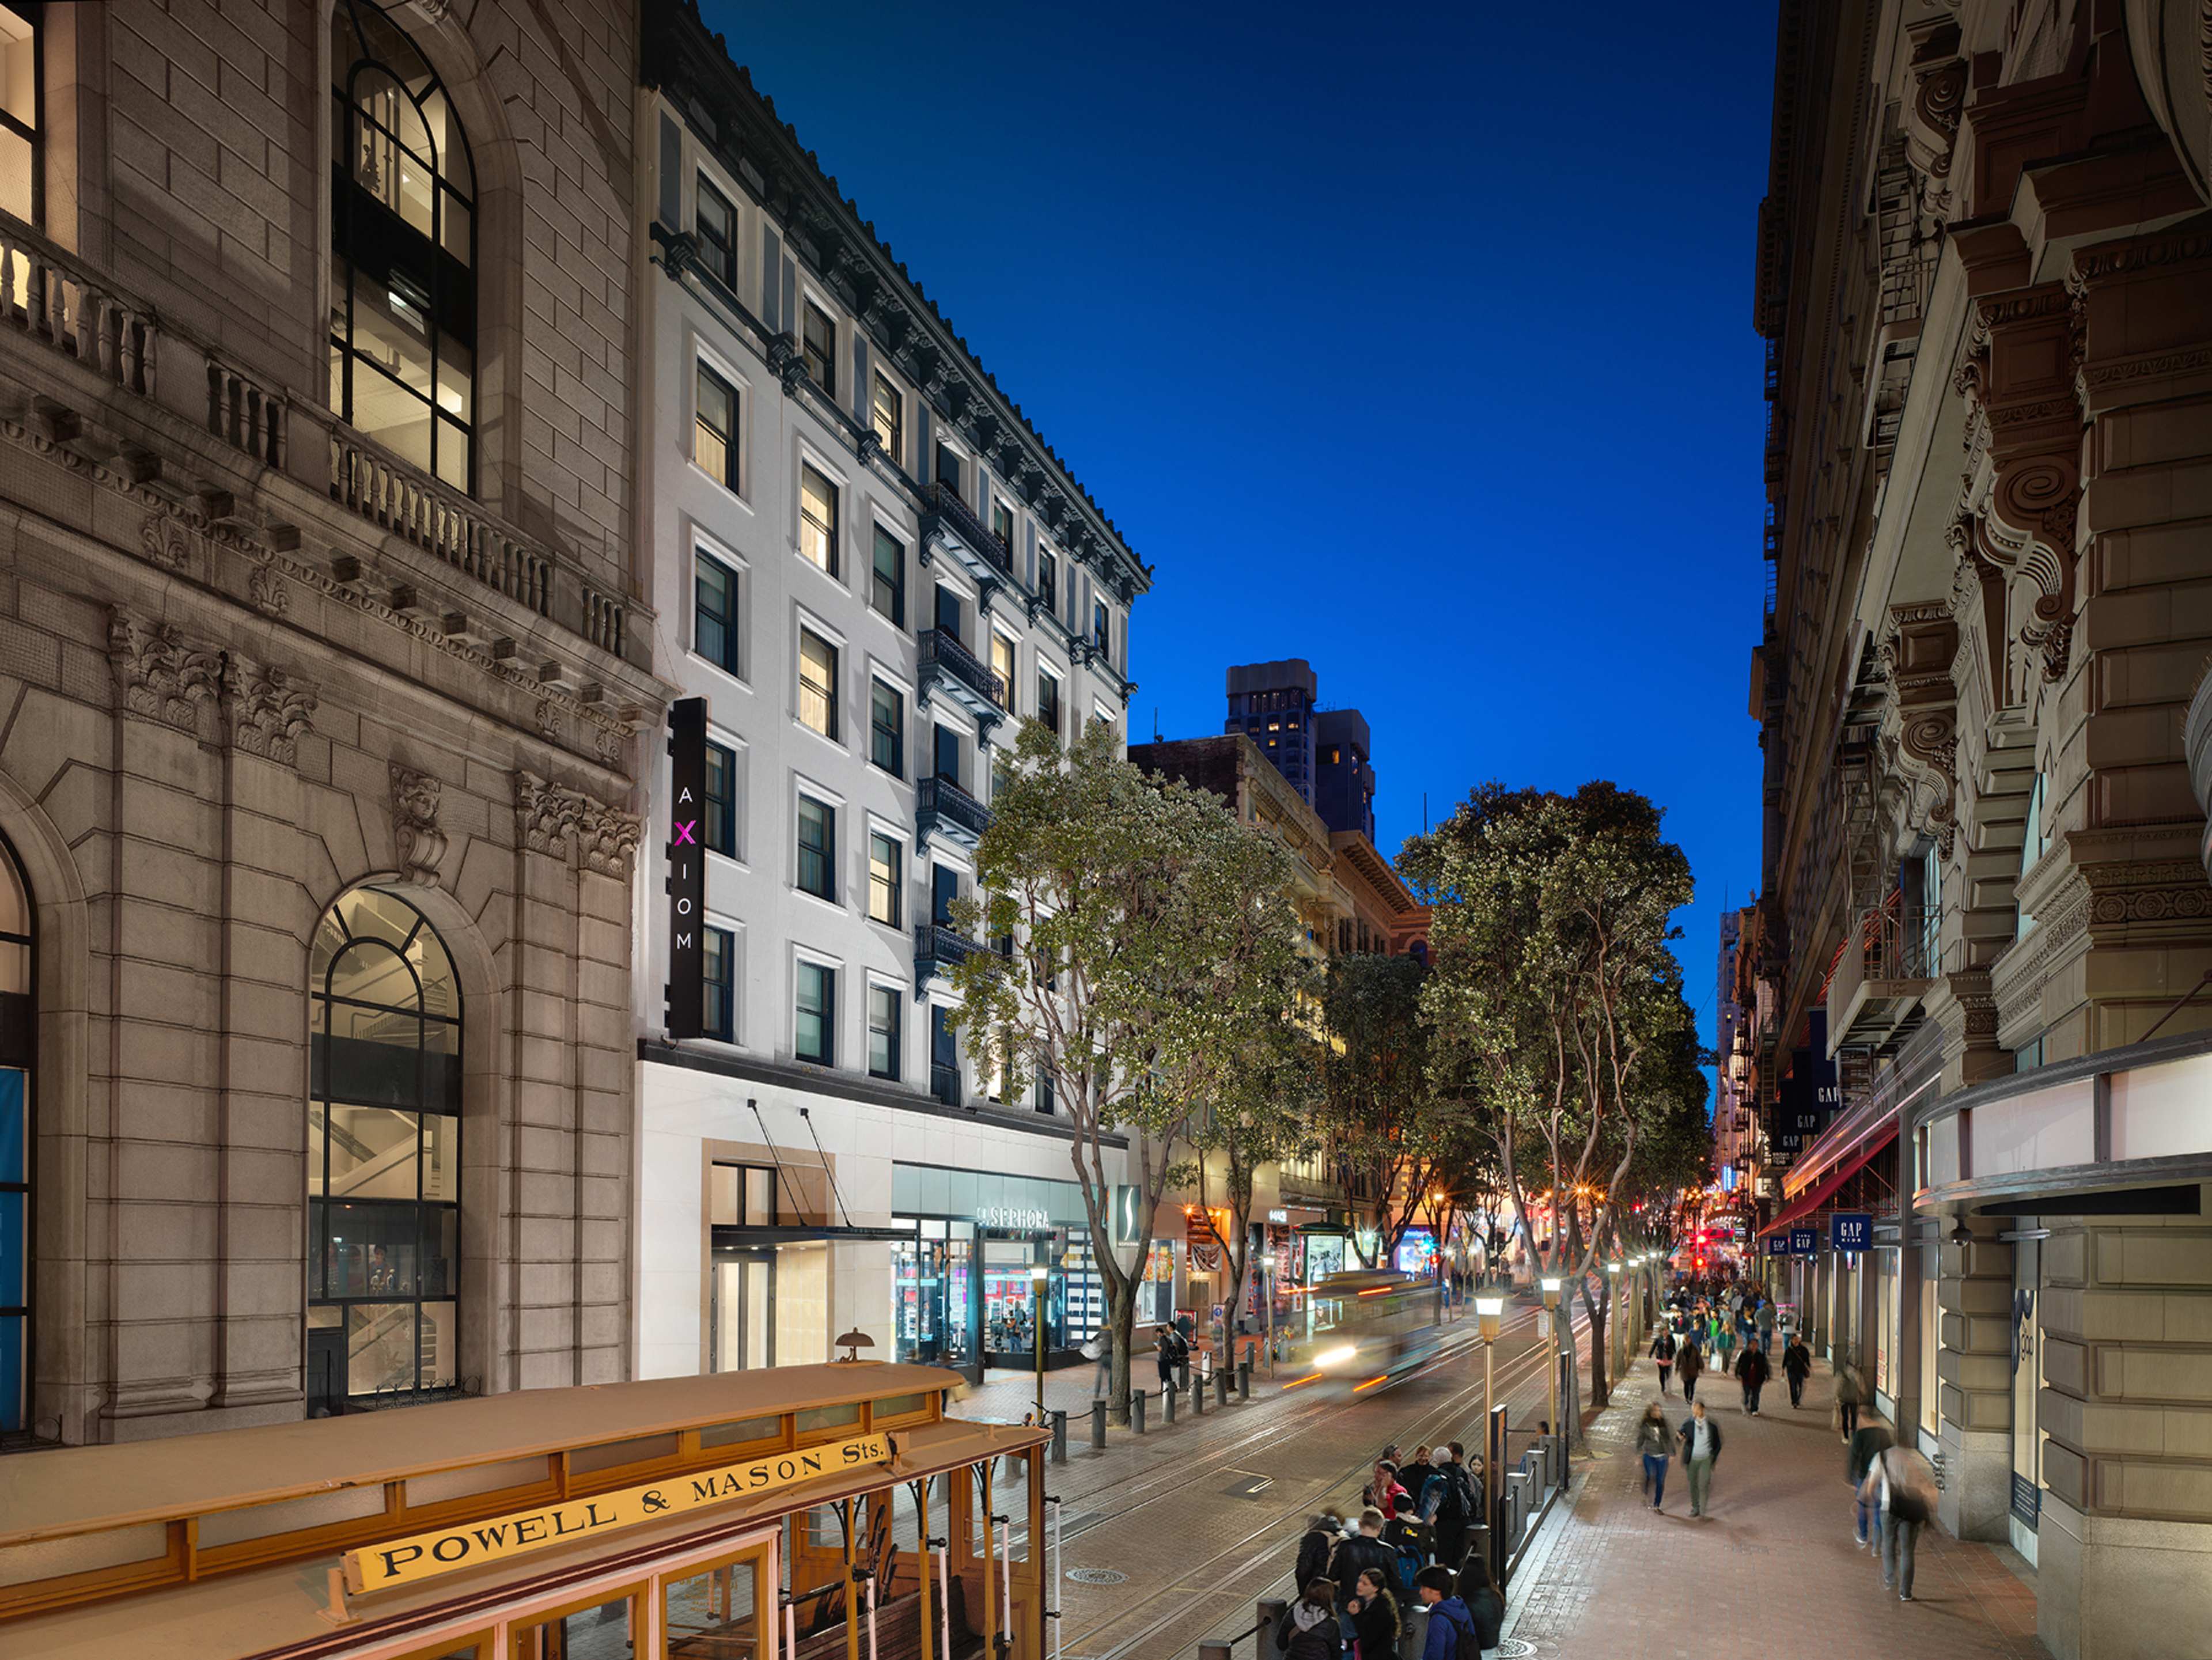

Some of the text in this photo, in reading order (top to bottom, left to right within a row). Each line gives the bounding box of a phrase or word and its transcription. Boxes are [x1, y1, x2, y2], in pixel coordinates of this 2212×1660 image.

[674, 787, 696, 949] AXIOM
[1797, 1115, 1816, 1128] GAP
[1782, 1135, 1799, 1147] GAP
[990, 1207, 1050, 1229] SEPHORA
[1840, 1222, 1862, 1237] GAP
[1796, 1238, 1810, 1249] GAP
[380, 1439, 884, 1578] POWELL & MASON Sts.
